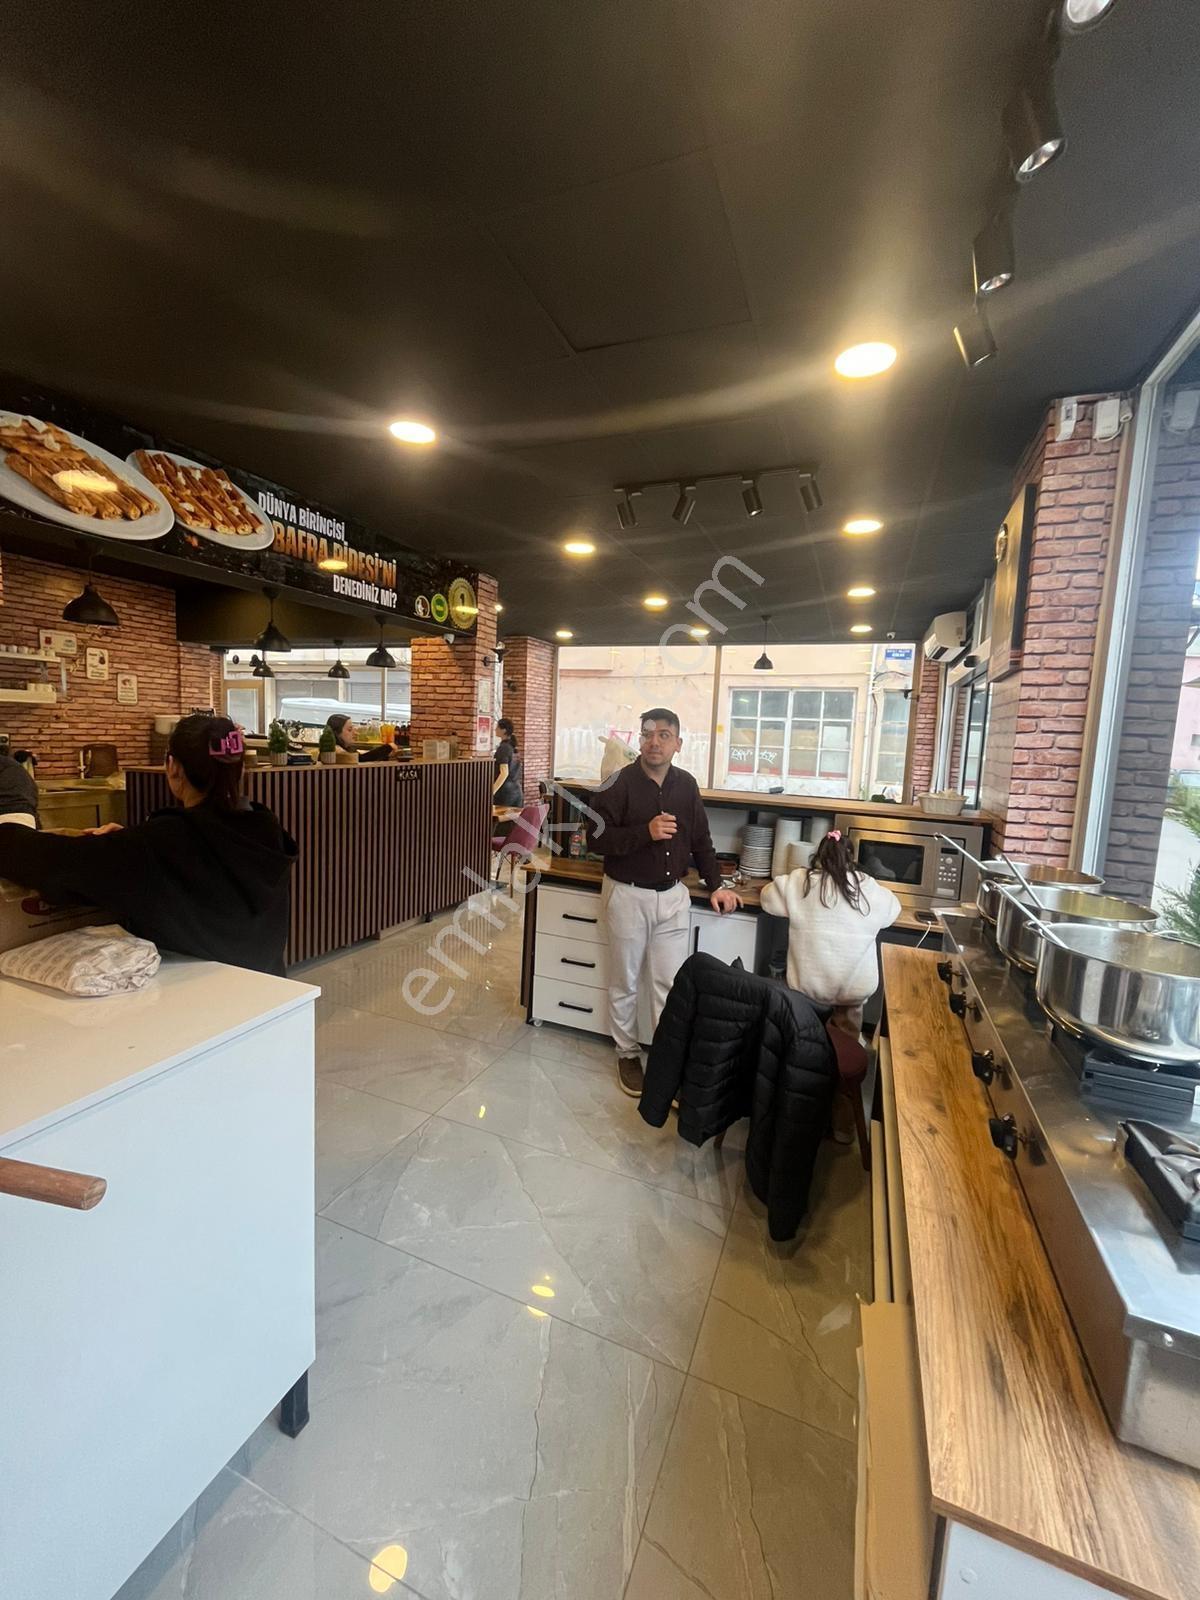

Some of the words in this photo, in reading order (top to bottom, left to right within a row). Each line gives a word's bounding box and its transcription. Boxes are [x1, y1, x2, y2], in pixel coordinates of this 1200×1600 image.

[258, 491, 297, 524] DÜNYA
[272, 520, 328, 566] BAFRA
[333, 574, 380, 606] DENEDİNİZ
[380, 589, 398, 609] Mİ?
